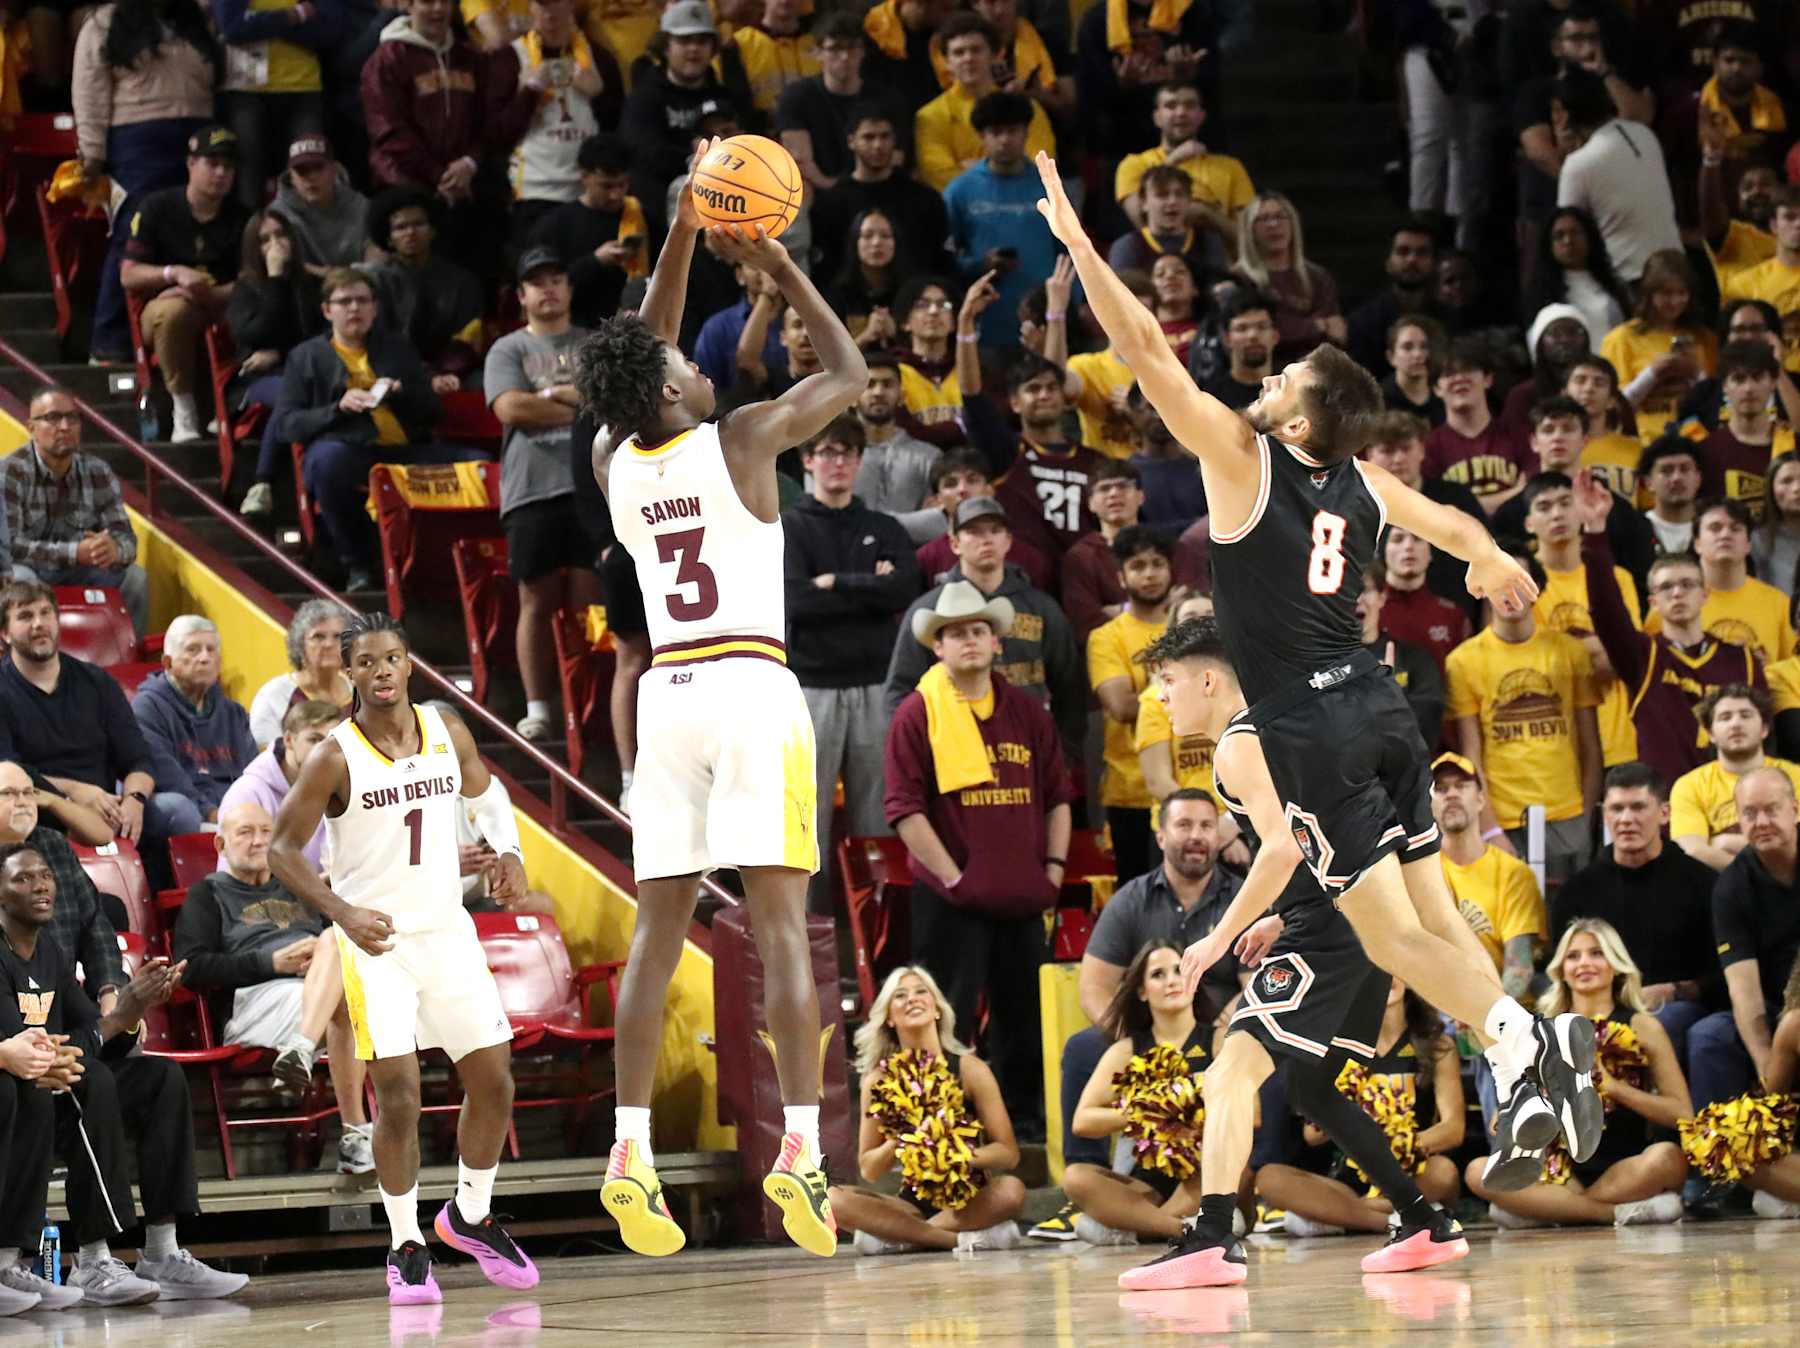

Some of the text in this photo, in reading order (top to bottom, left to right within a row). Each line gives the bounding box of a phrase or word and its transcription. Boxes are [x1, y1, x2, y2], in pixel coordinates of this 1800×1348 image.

[693, 183, 748, 214] Wilson
[641, 496, 701, 525] SANON
[1036, 481, 1082, 531] 21
[1307, 508, 1348, 597] 8
[654, 526, 719, 622] 3
[669, 672, 693, 685] ASU
[1492, 723, 1522, 741] SUN
[1178, 751, 1210, 769] SUN
[361, 775, 454, 810] SUN DEVILS
[961, 787, 1031, 807] UNIVERSITY
[404, 808, 423, 866] 1
[43, 1239, 53, 1281] WERADE
